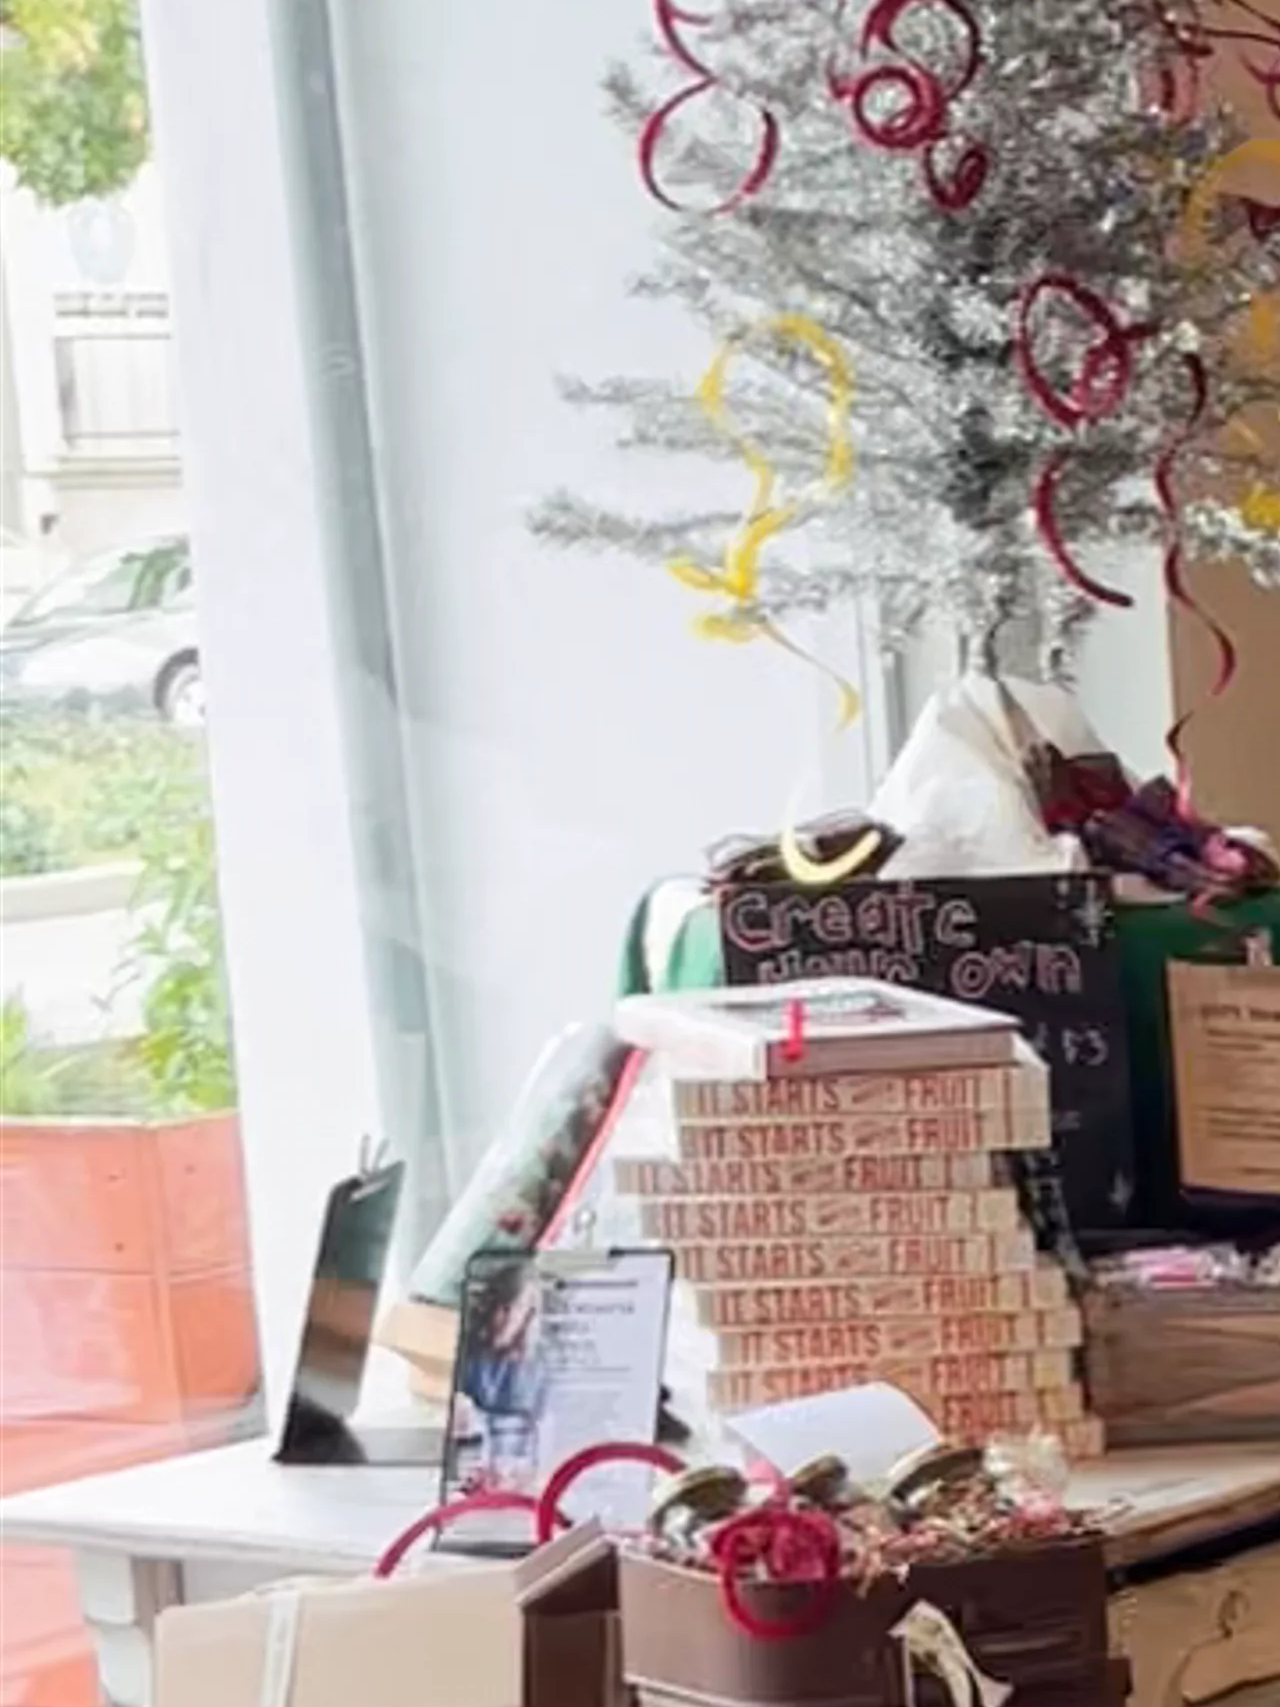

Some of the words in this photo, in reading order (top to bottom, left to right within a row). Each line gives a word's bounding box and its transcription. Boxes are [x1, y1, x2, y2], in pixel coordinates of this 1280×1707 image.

[725, 879, 978, 951] Create
[733, 1077, 839, 1113] STARTS
[904, 1073, 980, 1109] FRUIT
[737, 1122, 844, 1157] STARTS
[907, 1112, 985, 1149] FRUIT
[668, 1159, 781, 1193] STARTS
[844, 1154, 922, 1190] FRUIT
[662, 1201, 687, 1236] IT
[698, 1198, 806, 1237] STARTS
[869, 1195, 949, 1230] FRUIT
[682, 1249, 703, 1280] IT
[717, 1244, 825, 1279] STARTS
[888, 1239, 966, 1274] FRUIT
[719, 1291, 741, 1324] IT
[753, 1285, 860, 1324] STARTS
[923, 1276, 1000, 1311] FRUIT
[740, 1332, 762, 1364] IT
[773, 1324, 881, 1360] STARTS
[941, 1313, 1017, 1350] FRUIT
[931, 1351, 1008, 1387] FRUIT
